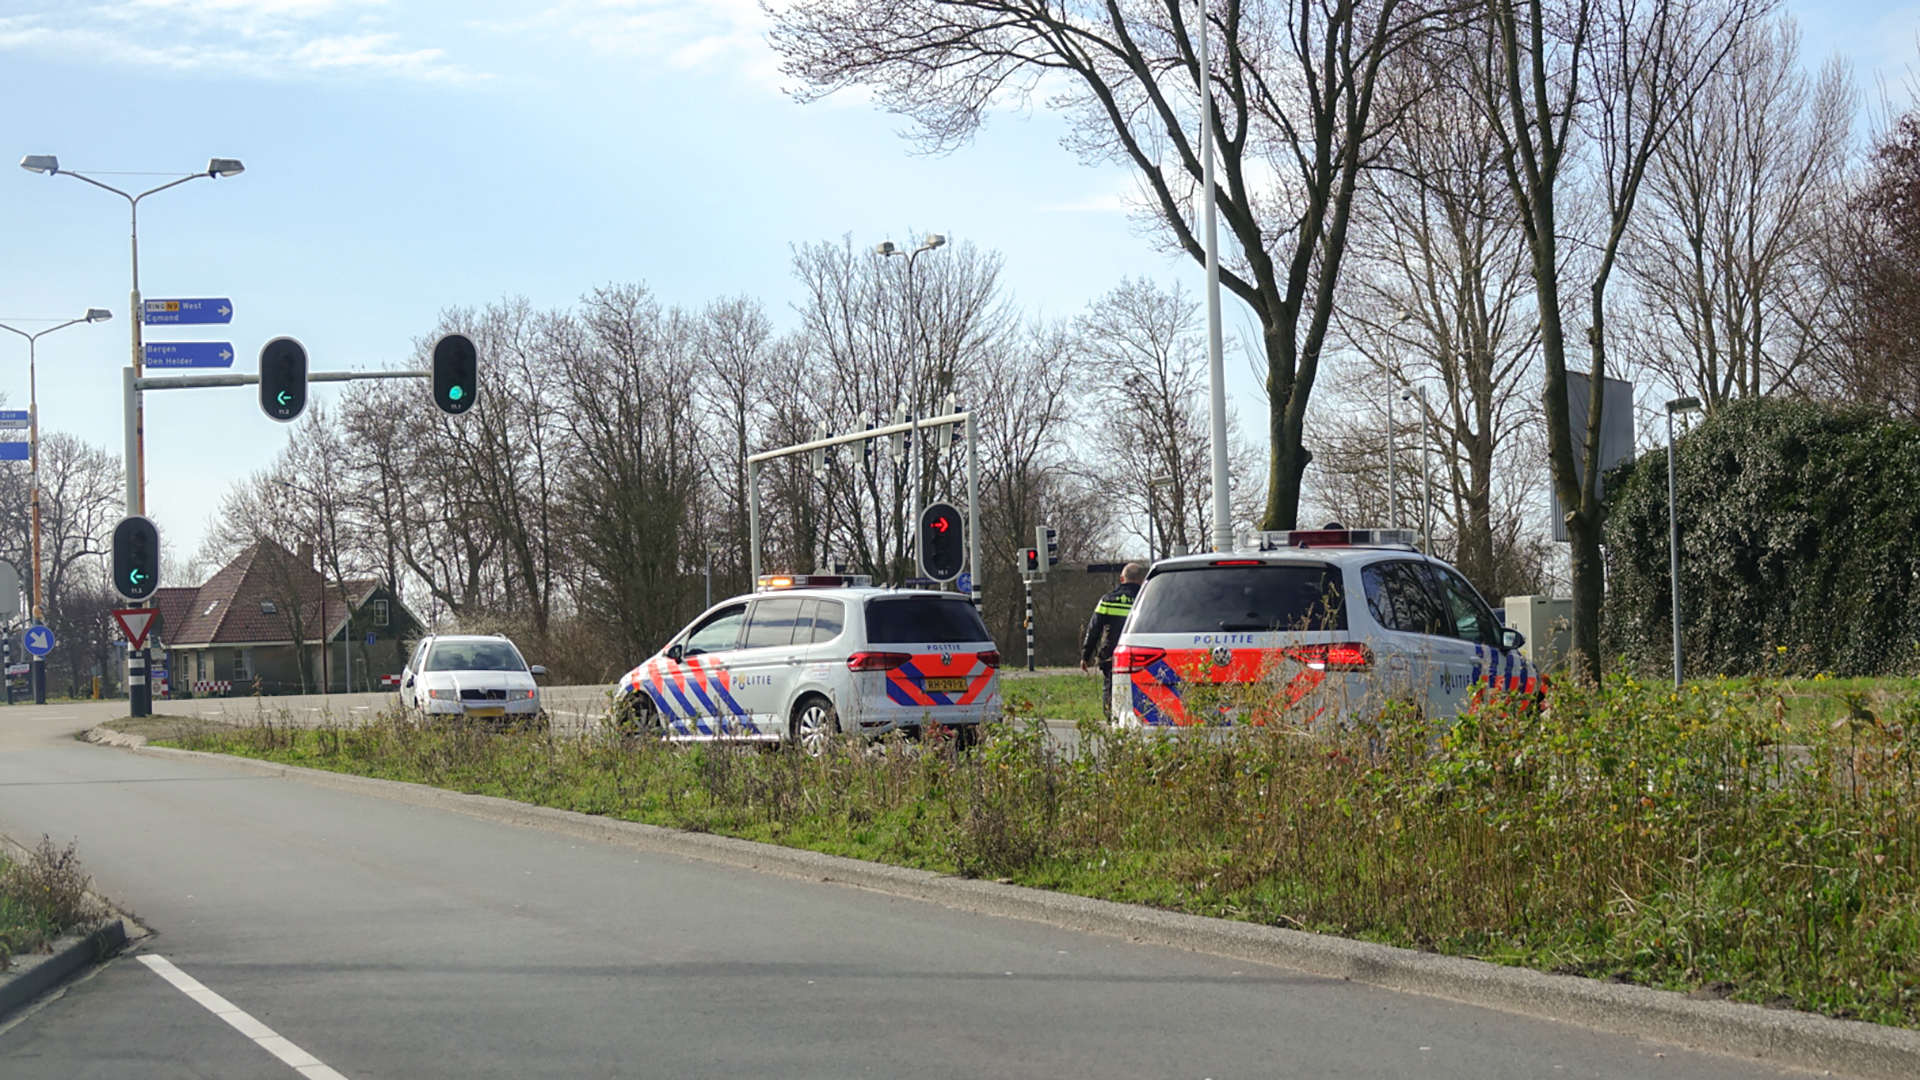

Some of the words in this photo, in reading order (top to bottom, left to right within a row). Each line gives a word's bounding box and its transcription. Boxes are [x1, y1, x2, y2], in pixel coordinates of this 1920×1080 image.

[166, 302, 178, 310] N9
[182, 302, 202, 310] West
[146, 314, 179, 322] Egmond
[147, 345, 177, 354] Bergen
[147, 357, 163, 365] Den
[165, 357, 193, 365] Helder
[1193, 634, 1254, 644] POLITIE
[732, 673, 772, 690] POLITIE
[928, 680, 964, 689] RH-291-X
[1440, 674, 1471, 694] POLITIE
